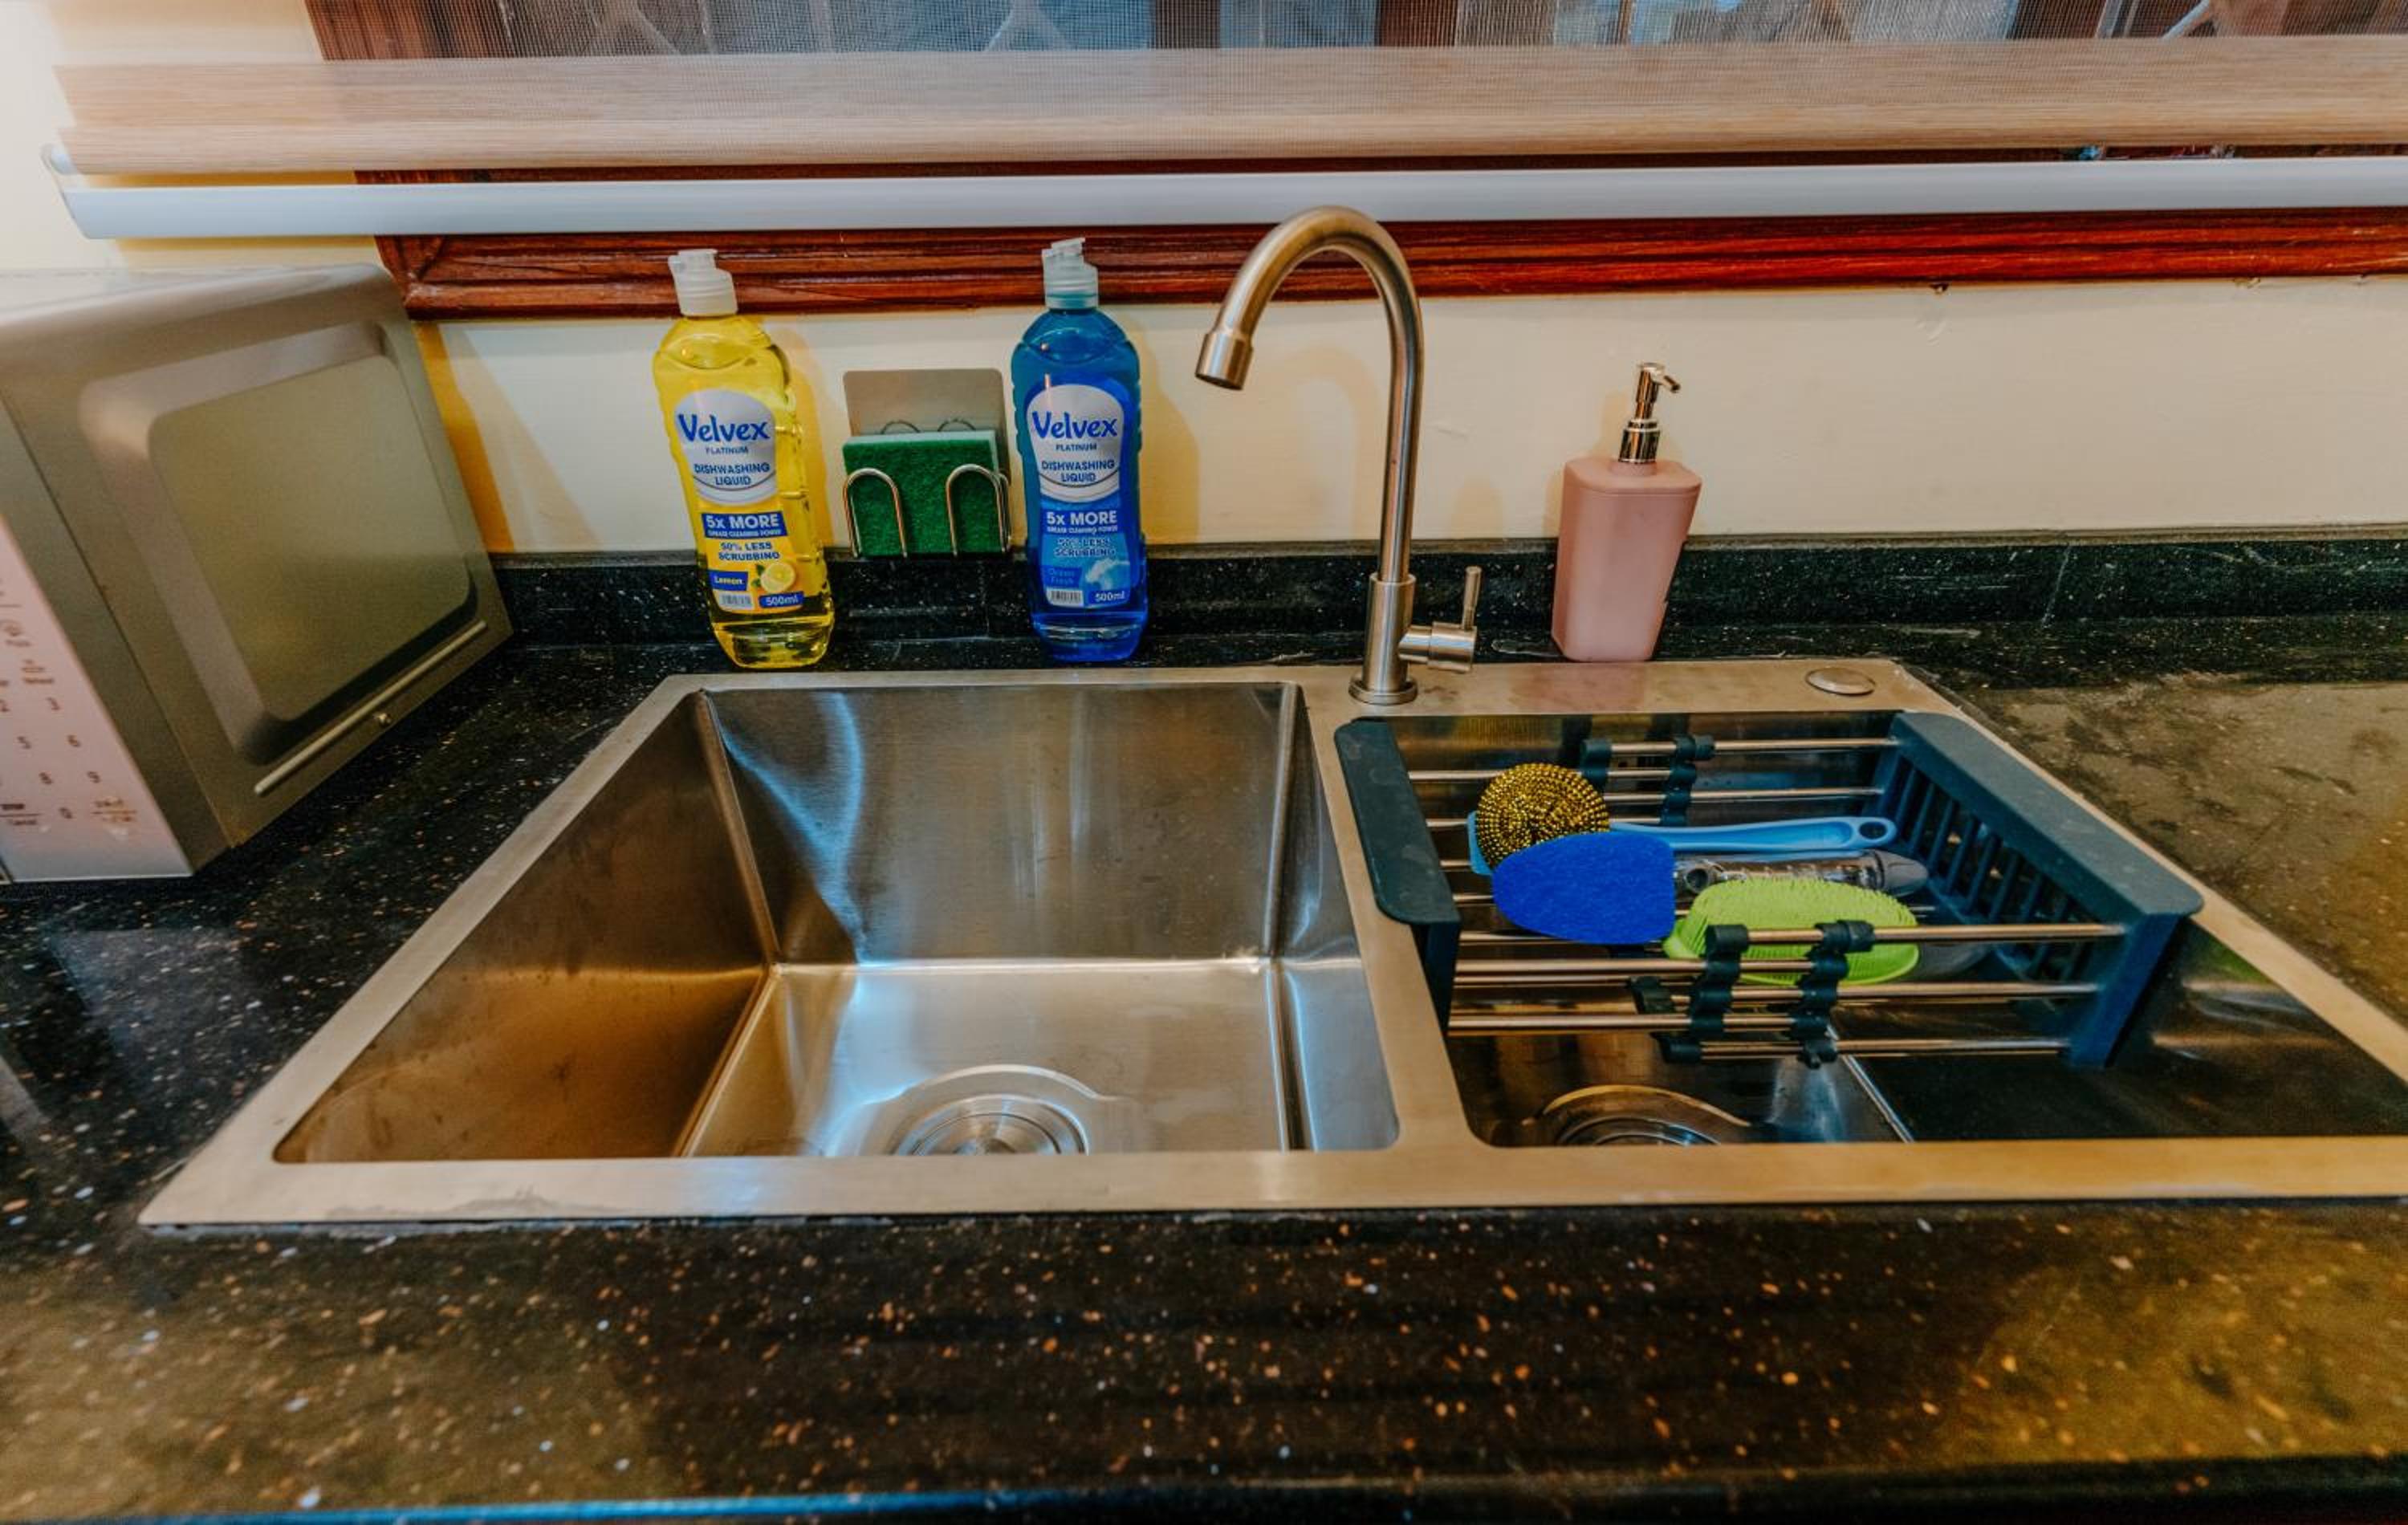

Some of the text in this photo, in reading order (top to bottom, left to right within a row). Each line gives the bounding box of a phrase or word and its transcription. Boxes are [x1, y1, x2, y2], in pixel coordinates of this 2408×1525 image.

[678, 413, 771, 442] Velvex
[1032, 411, 1118, 439] Velvex
[706, 446, 749, 455] PLATINUM
[1056, 442, 1097, 451] PLATINUM
[694, 462, 771, 474] DISHWASHING
[1041, 459, 1115, 471] DISHWASHING
[715, 476, 752, 486] LIQUID
[1061, 473, 1096, 482] LIQUID
[706, 513, 779, 529] 5x MORE
[1046, 510, 1118, 526] 5x MORE
[745, 541, 773, 551] LESS
[718, 551, 780, 561] SCRUBBING
[1054, 547, 1117, 557] SCRUBBING
[714, 575, 743, 584] Lemon
[765, 595, 799, 606] 500ml
[1094, 590, 1126, 602] 500ml
